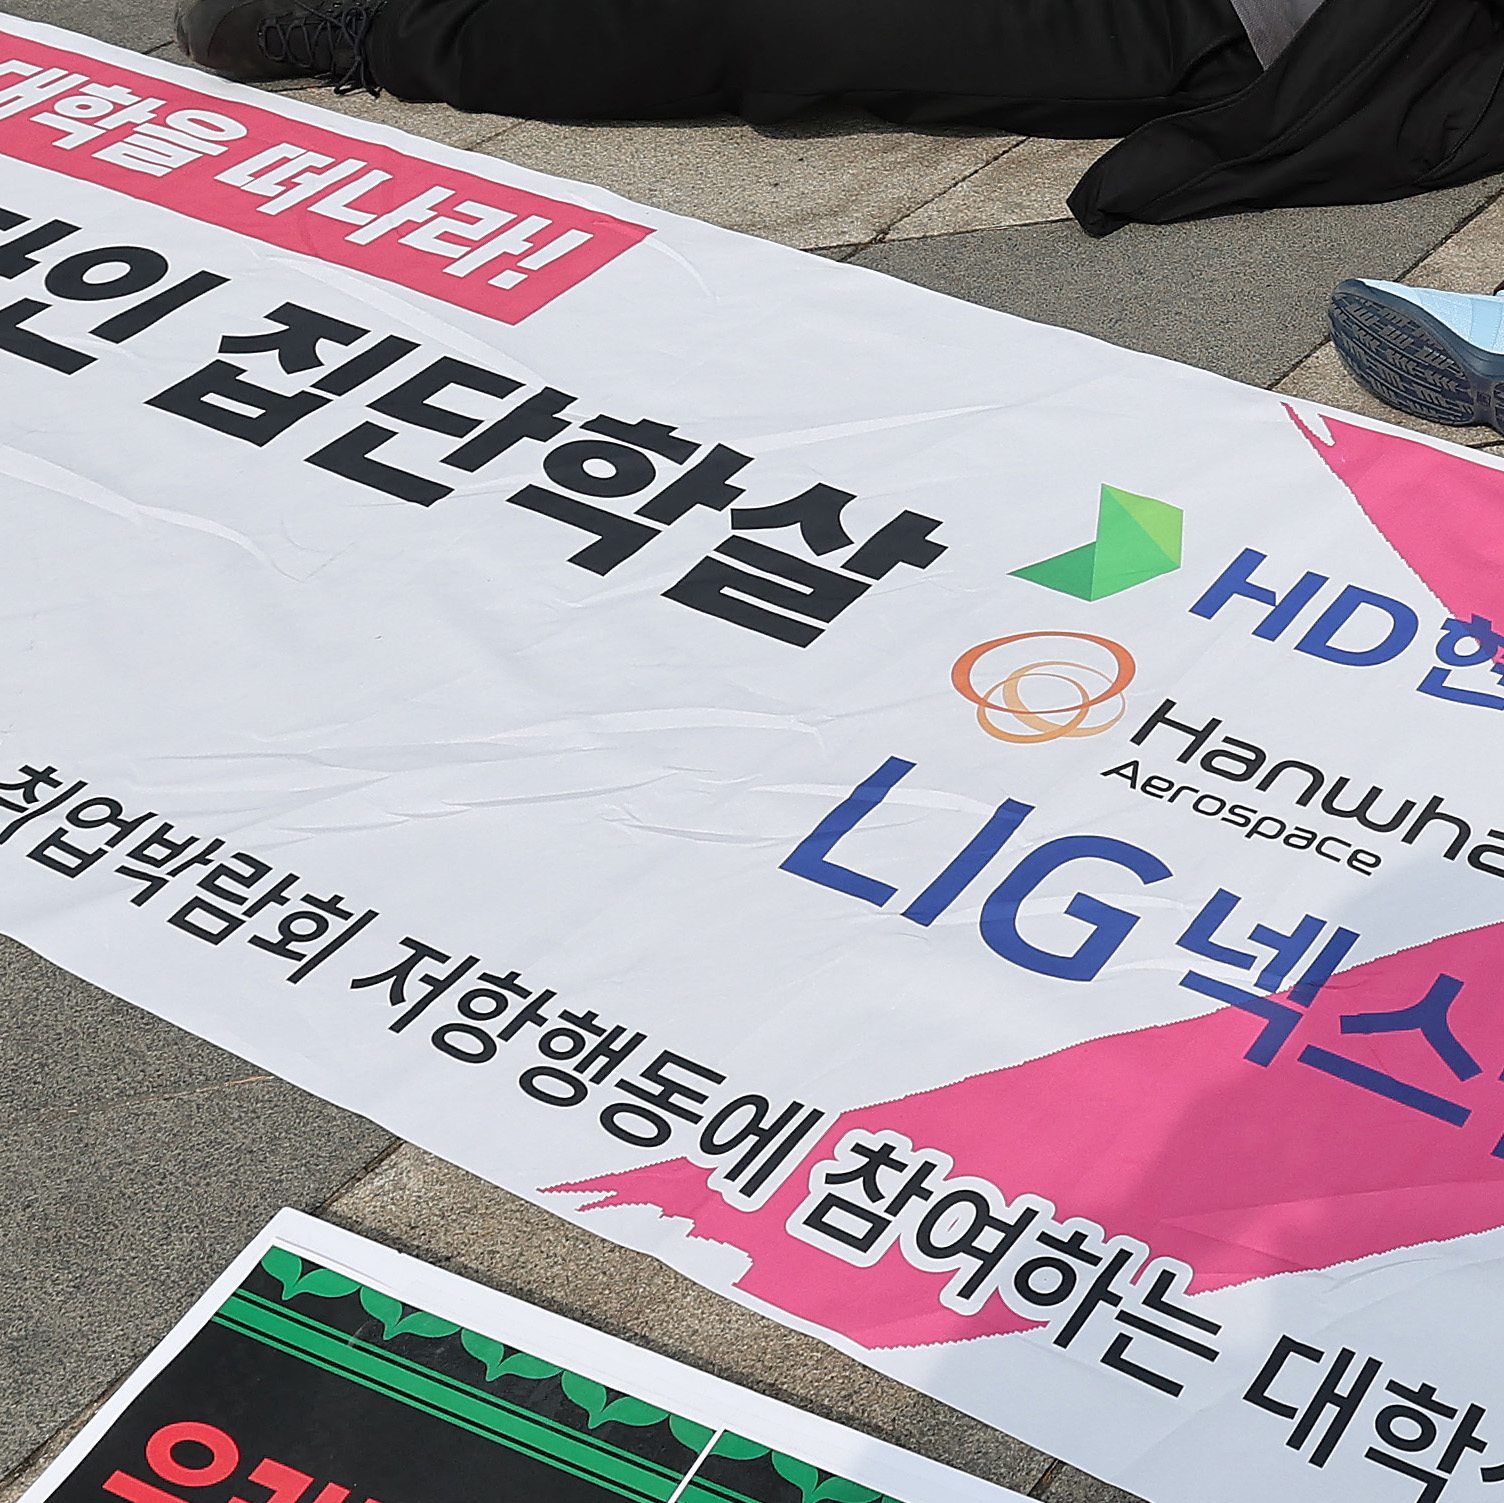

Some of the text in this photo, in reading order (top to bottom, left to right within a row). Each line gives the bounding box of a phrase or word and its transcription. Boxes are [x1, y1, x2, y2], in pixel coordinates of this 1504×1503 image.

[0, 58, 594, 290] 대학을 떠나라!
[144, 301, 949, 648] 집단학살
[1100, 759, 1382, 877] Aerospace
[0, 762, 379, 985] 취업박람회
[350, 937, 825, 1198] 저항행동에
[802, 1141, 1223, 1398] 참여하는
